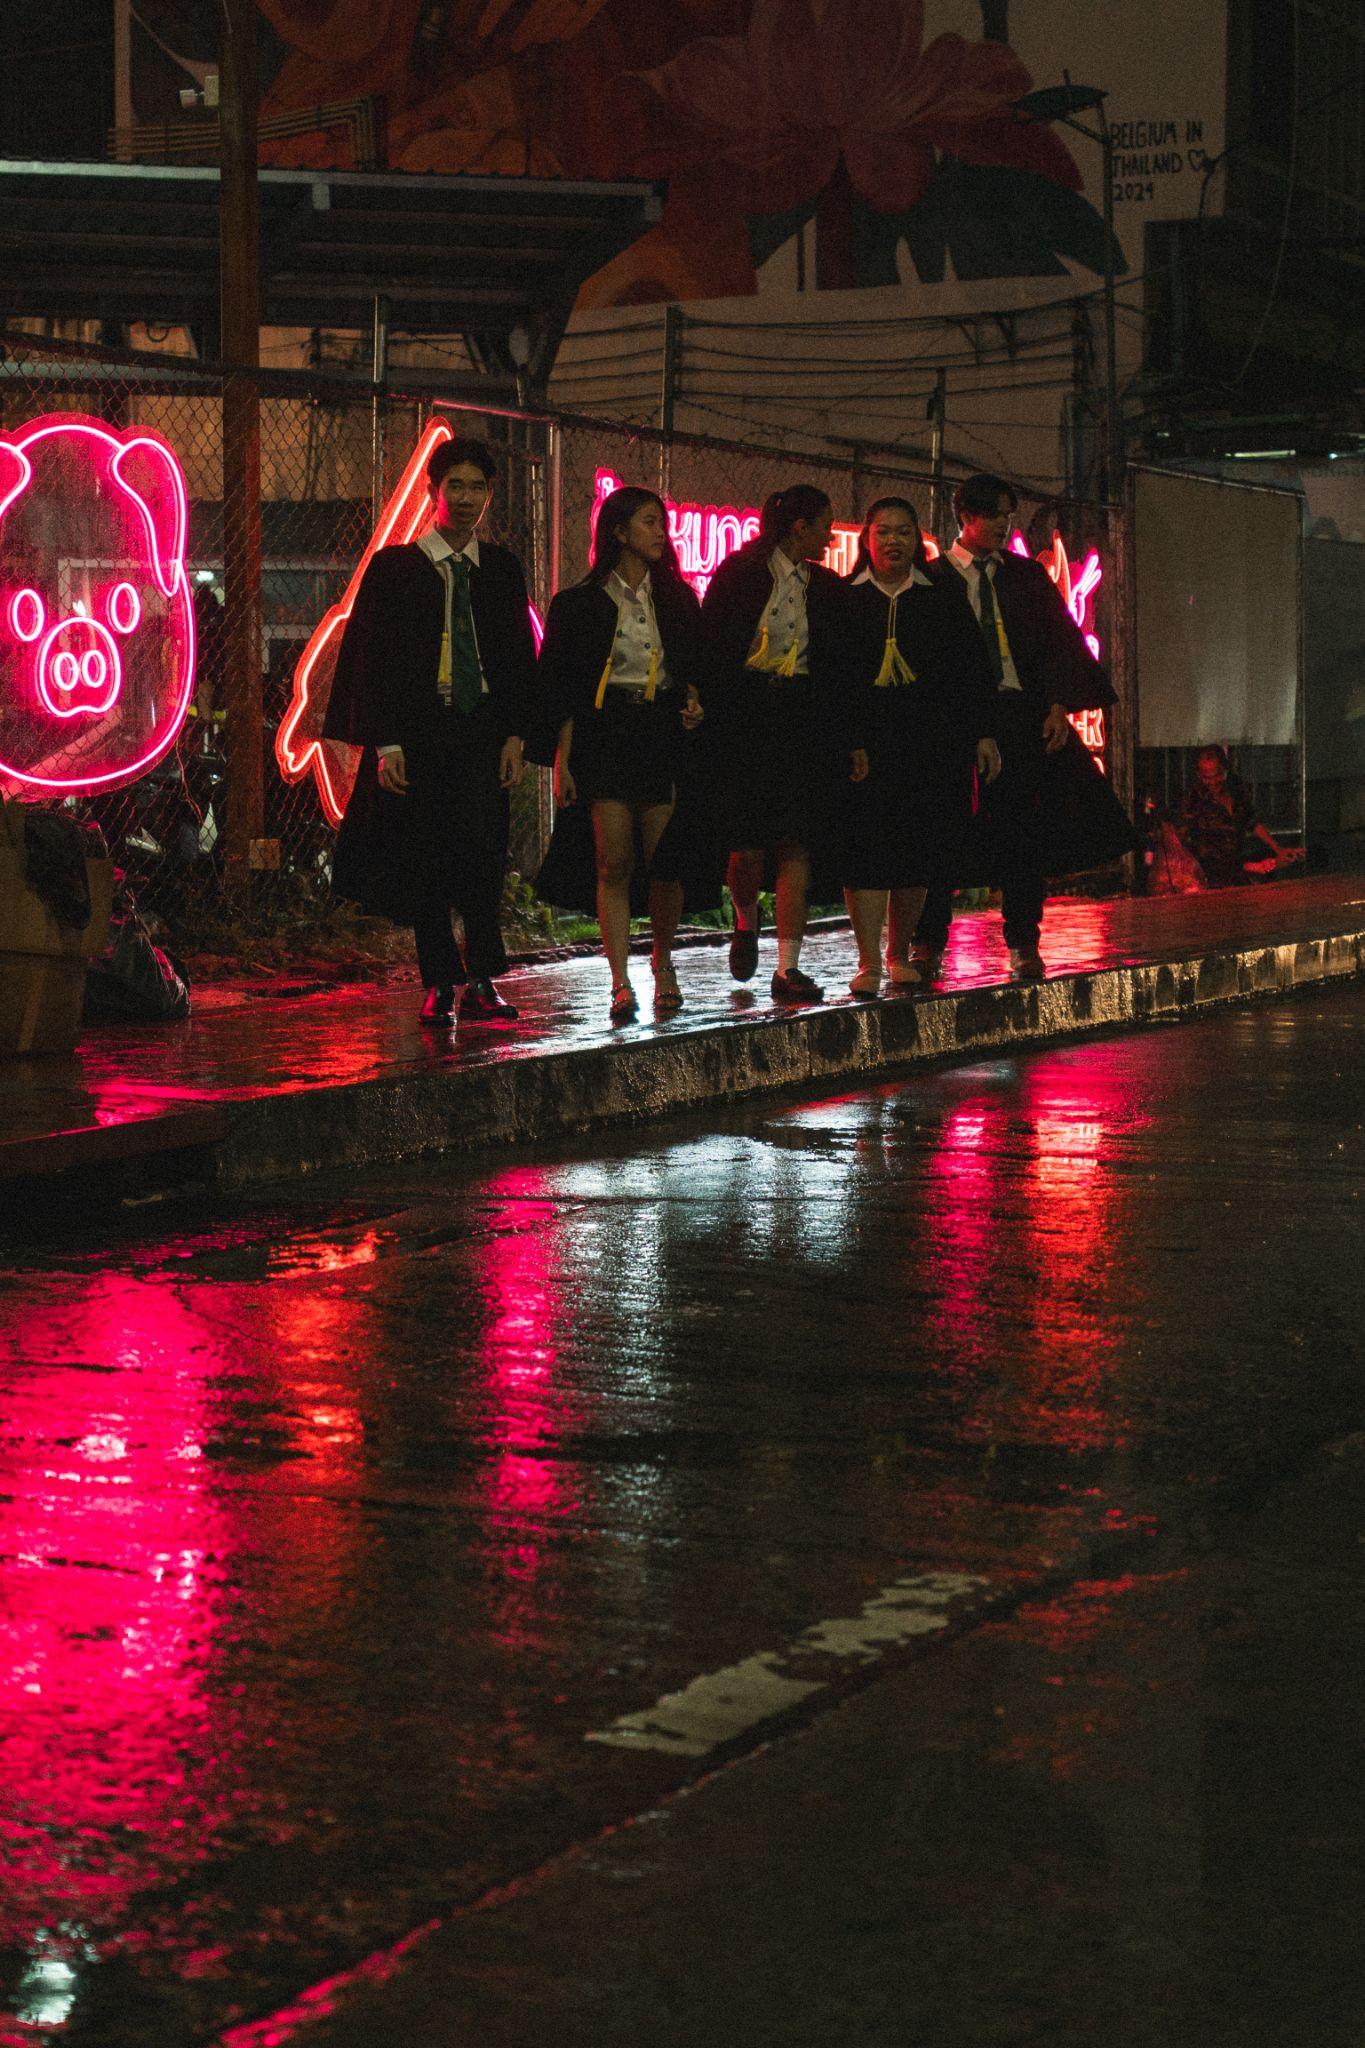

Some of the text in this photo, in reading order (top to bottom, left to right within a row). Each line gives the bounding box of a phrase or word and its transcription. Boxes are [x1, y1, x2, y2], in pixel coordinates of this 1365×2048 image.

[1110, 120, 1203, 149] BELGIUM IN
[1112, 153, 1183, 177] THAILAND
[1113, 182, 1154, 201] 2024
